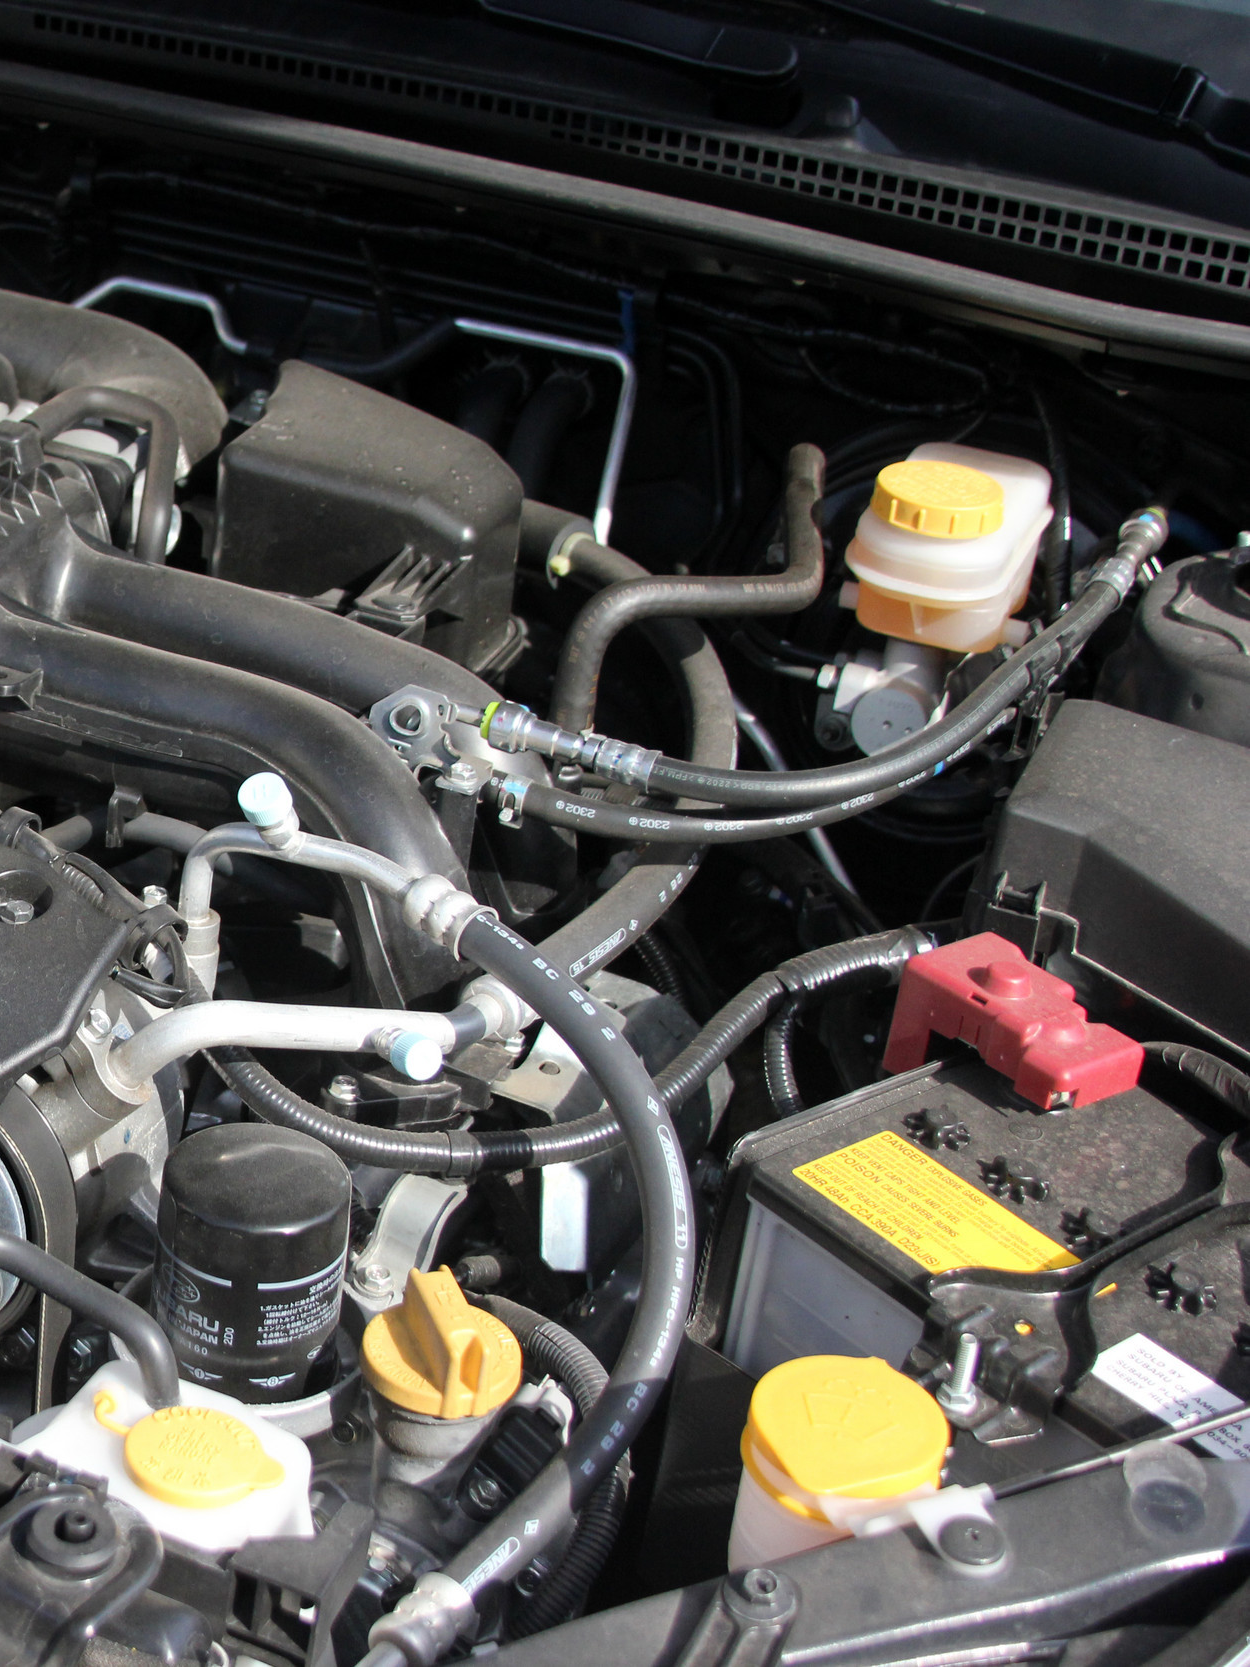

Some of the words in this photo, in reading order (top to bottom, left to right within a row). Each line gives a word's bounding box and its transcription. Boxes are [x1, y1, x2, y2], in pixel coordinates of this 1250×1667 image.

[566, 803, 596, 818] 2302
[639, 818, 670, 830] 2302
[532, 957, 559, 980] BC
[568, 989, 596, 1016] 29
[601, 1026, 616, 1041] 2
[851, 1148, 869, 1159] KEEP
[868, 1160, 887, 1172] VENT
[885, 1171, 905, 1184] CAPS
[904, 1184, 926, 1198] TIGHT
[924, 1199, 941, 1209] AND
[939, 1208, 959, 1224] LEVEL
[881, 1134, 928, 1165] DANGER
[927, 1166, 963, 1190] EXPLOSIVE
[962, 1190, 987, 1206] GASES
[813, 1163, 832, 1175] KEEP
[830, 1173, 847, 1186] OUT
[844, 1183, 856, 1192] OF
[854, 1192, 878, 1208] REACH
[876, 1207, 888, 1215] OF
[887, 1215, 923, 1240] CHILDREN
[837, 1152, 881, 1183] POISON
[881, 1184, 909, 1202] CAUSES
[909, 1202, 935, 1220] SEVERE
[933, 1220, 958, 1238] BURNS
[799, 1169, 828, 1186] 20HR
[825, 1184, 850, 1204] 48Ah
[850, 1204, 874, 1221] CCA
[872, 1220, 897, 1236] 390A
[898, 1237, 940, 1266] D23(JIS)
[674, 1256, 684, 1280] HP
[179, 1322, 218, 1346] JAPAN
[1106, 1365, 1144, 1390] CHERRY
[1128, 1353, 1172, 1383] SUBARU
[1175, 1384, 1191, 1394] OF
[1136, 1348, 1165, 1368] SOLD
[1168, 1369, 1185, 1378] BY
[626, 1382, 648, 1411] BC
[1116, 1360, 1155, 1386] SUBARU
[1158, 1386, 1188, 1409] PLAZA
[1218, 1427, 1242, 1444] BOX
[580, 1458, 596, 1475] 2
